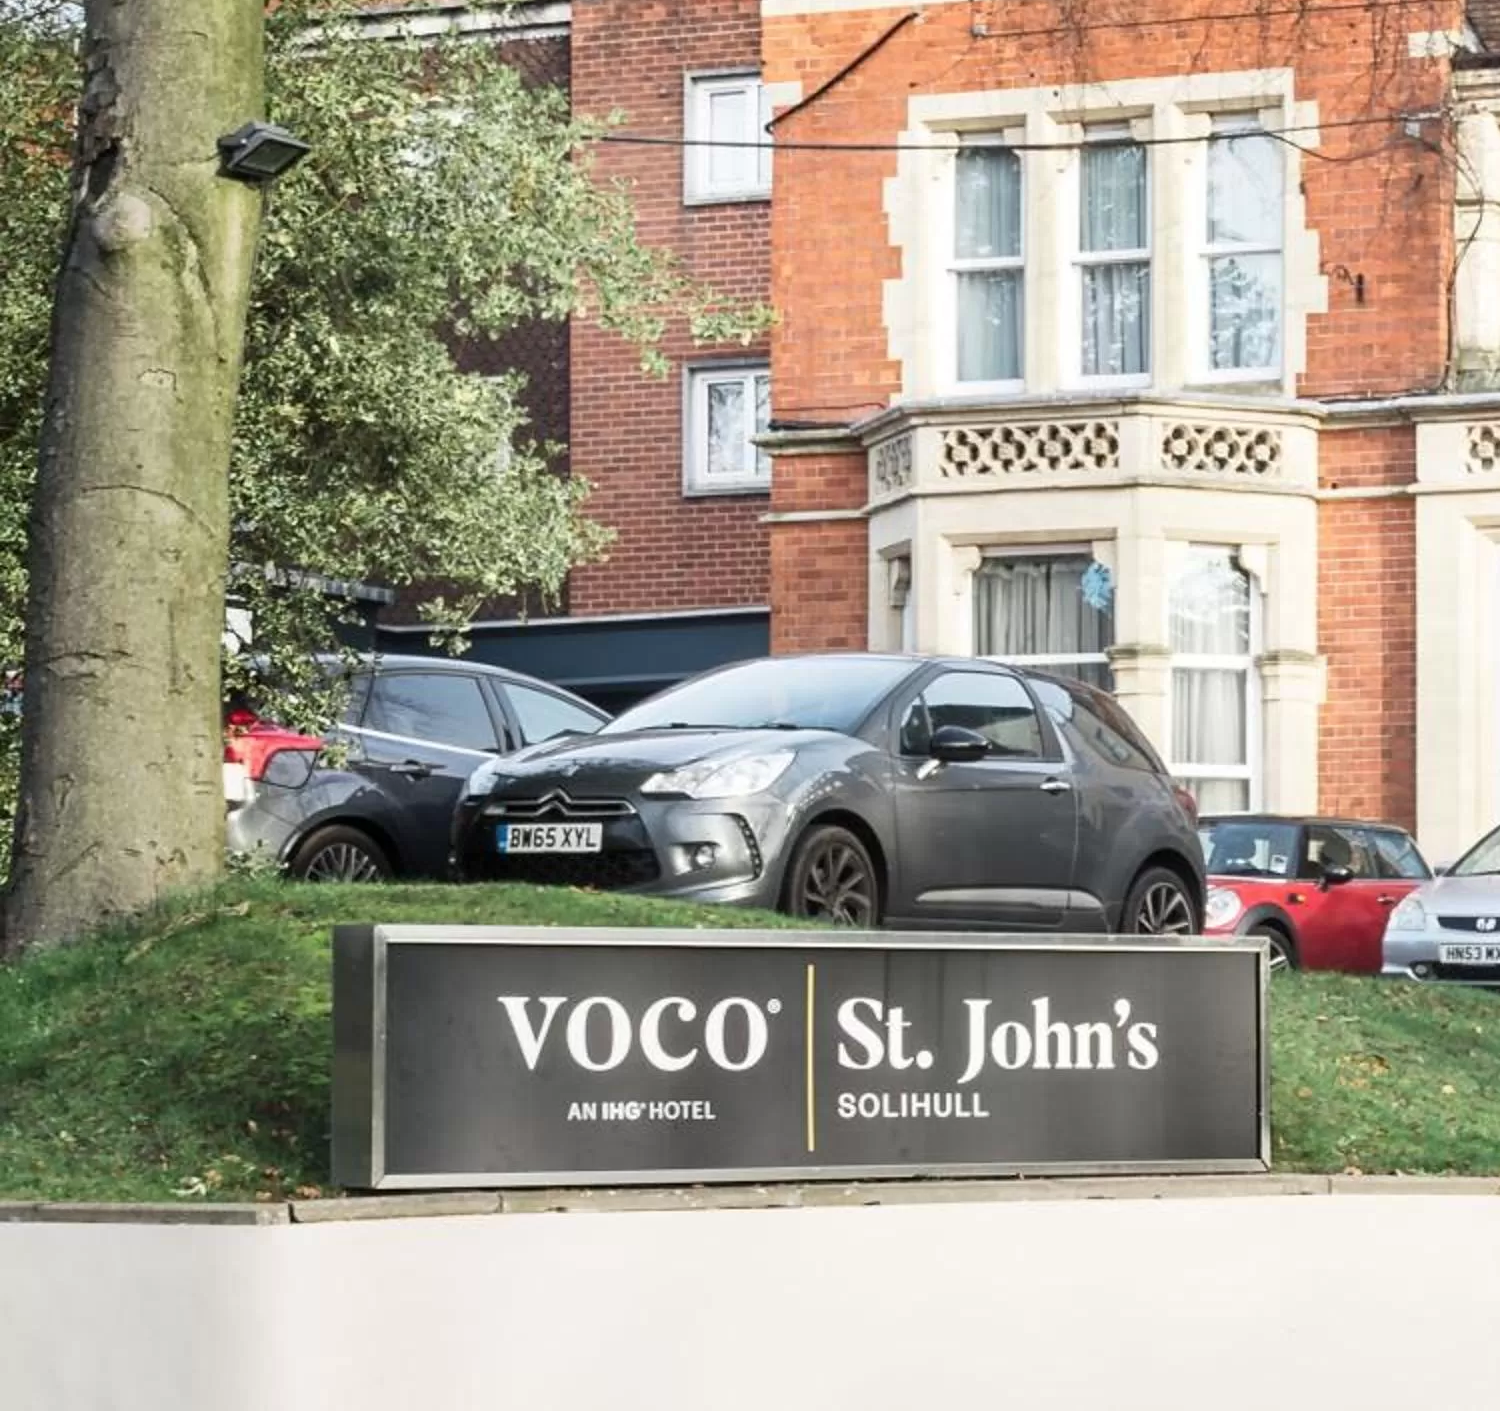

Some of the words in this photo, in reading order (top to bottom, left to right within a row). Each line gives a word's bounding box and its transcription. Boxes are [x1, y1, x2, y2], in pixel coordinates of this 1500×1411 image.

[562, 826, 597, 848] XYL
[838, 997, 934, 1069] St.
[567, 1102, 597, 1120] AN
[650, 1101, 716, 1120] HOTEL
[837, 1092, 990, 1118] SOLIHULL
